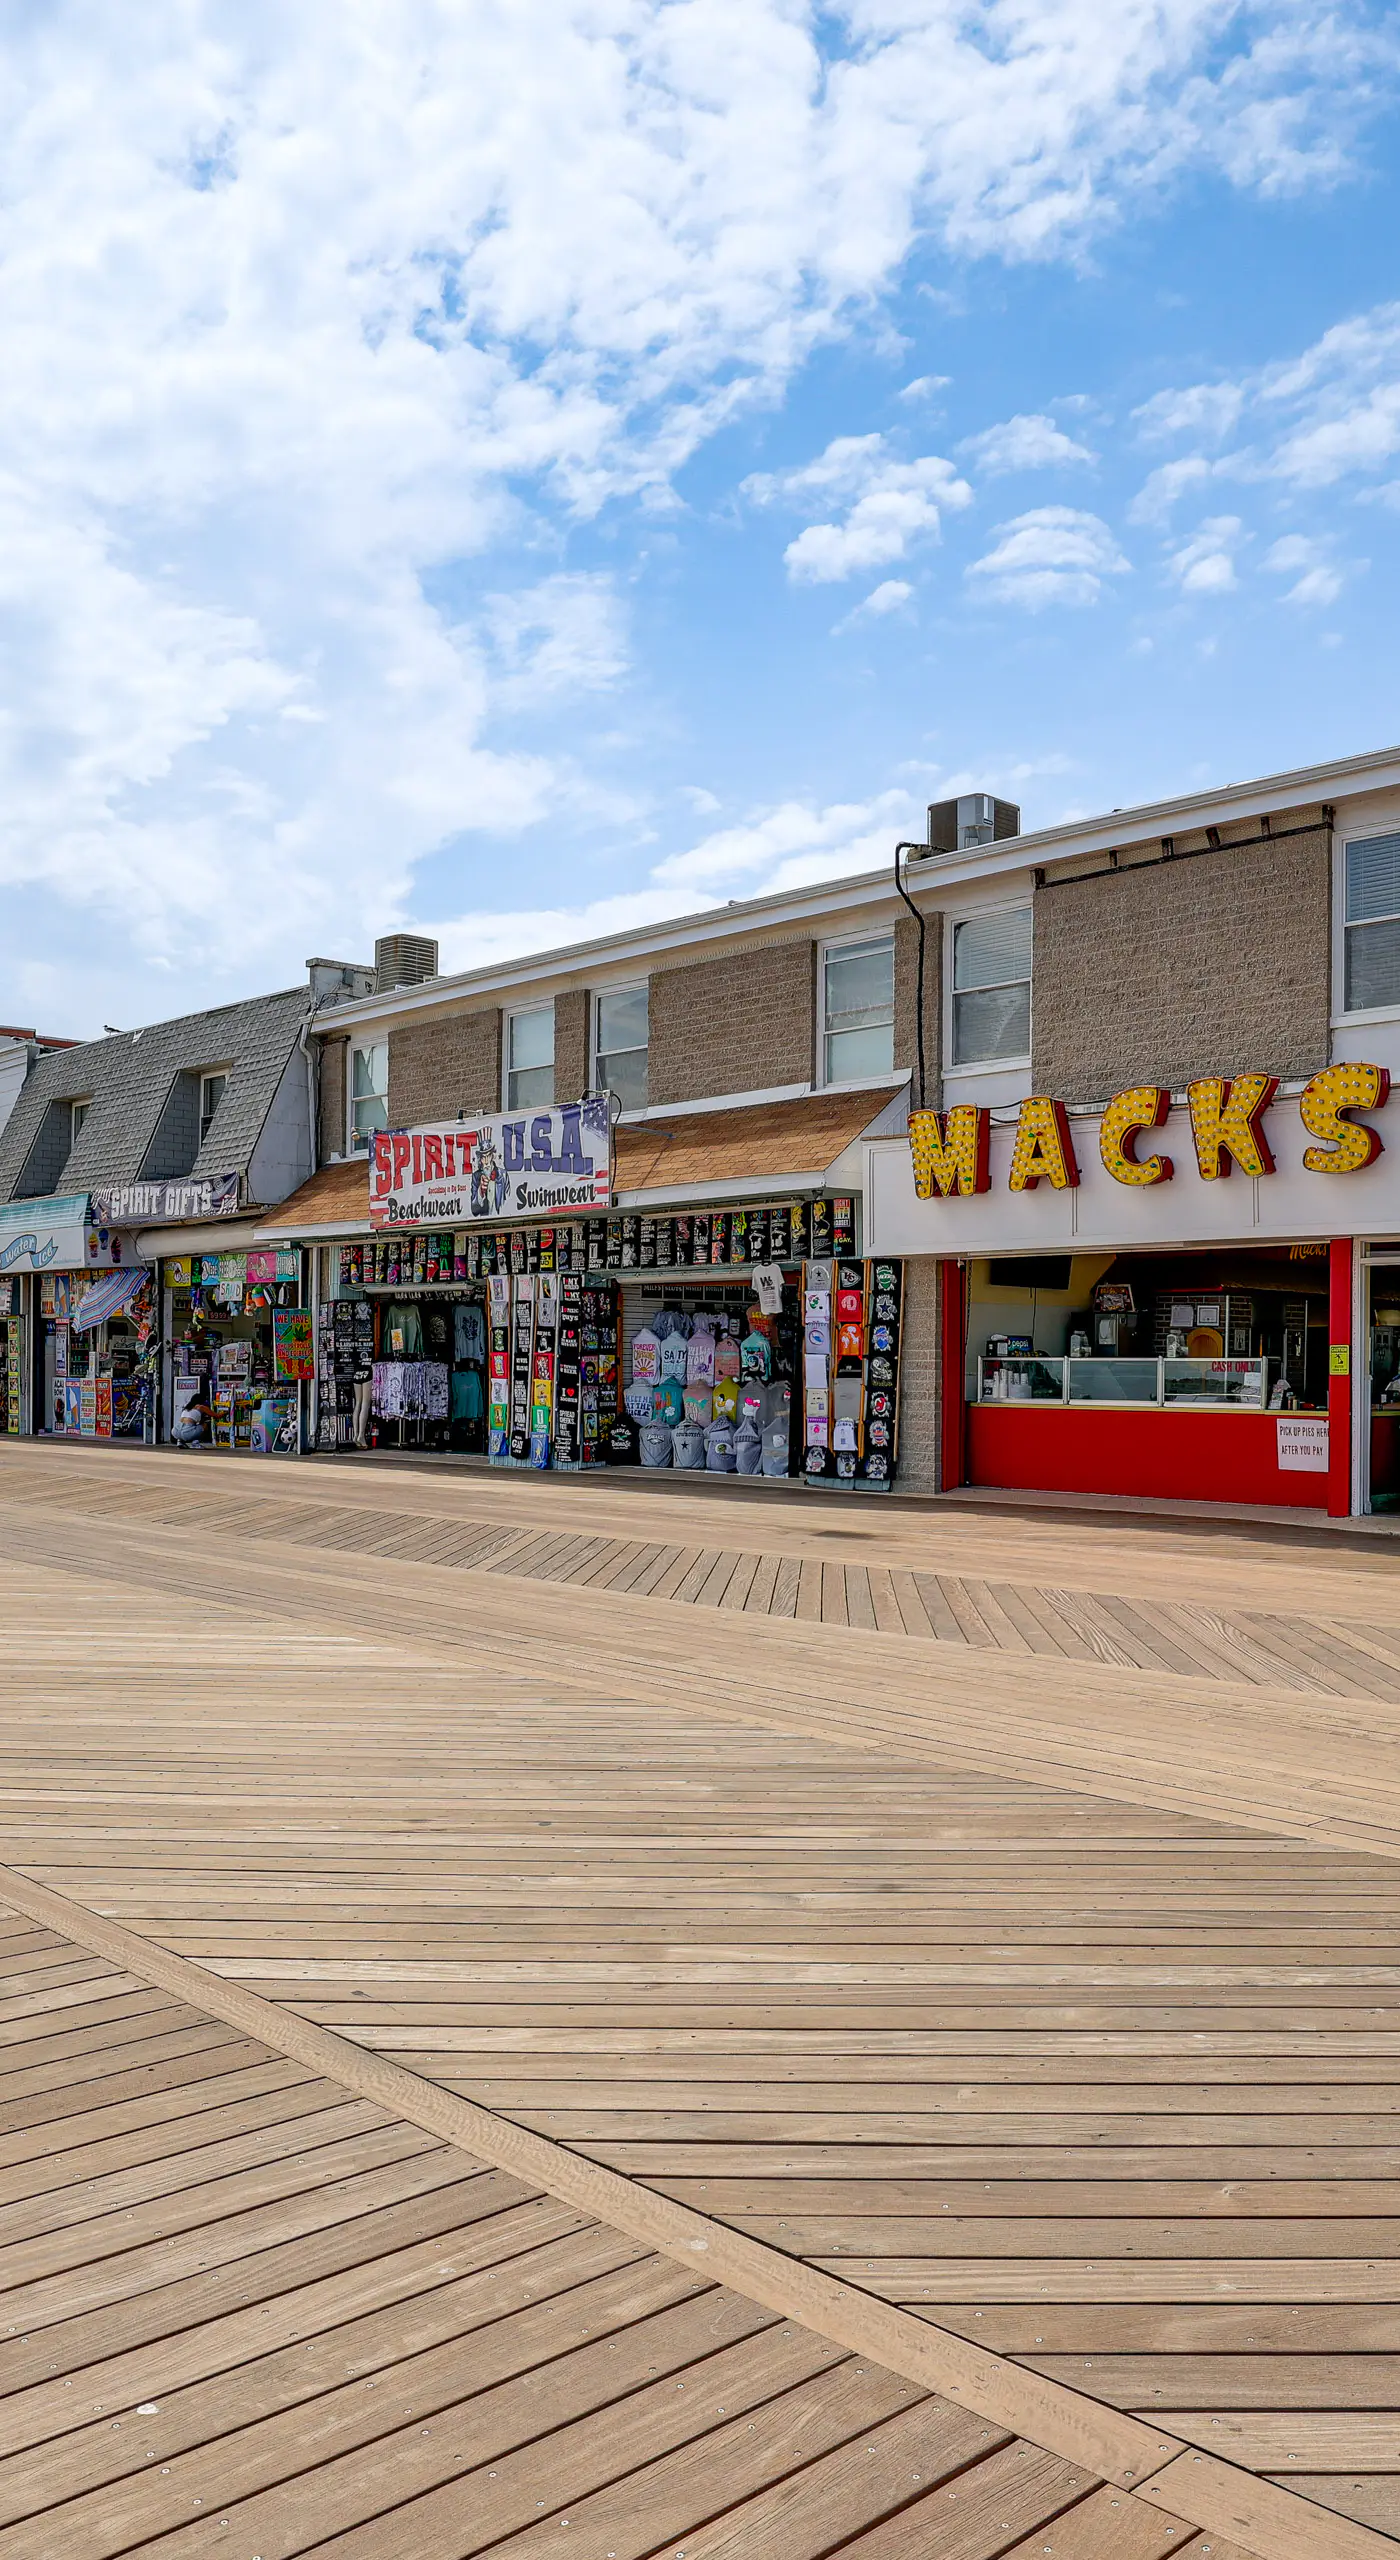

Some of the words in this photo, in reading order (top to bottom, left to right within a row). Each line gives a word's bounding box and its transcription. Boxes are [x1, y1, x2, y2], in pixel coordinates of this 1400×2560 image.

[908, 1062, 1391, 1200] MACKS
[375, 1131, 478, 1196] SPIRIT
[110, 1185, 160, 1220] SPIRIT
[164, 1180, 213, 1218] GIFTS
[388, 1195, 463, 1222] Beachwear
[516, 1181, 596, 1210] Swimwear
[38, 1246, 53, 1266] Ice
[277, 1315, 288, 1323] WE
[290, 1314, 309, 1323] HAVE
[1011, 1339, 1029, 1348] pepsi
[1211, 1361, 1232, 1372] CASH
[1235, 1361, 1256, 1372] ONLY
[1280, 1426, 1293, 1436] PICK
[1293, 1427, 1301, 1436] UP
[1302, 1427, 1315, 1437] PIES
[1281, 1445, 1299, 1455] AFTER
[1300, 1445, 1311, 1455] YOU
[1313, 1446, 1324, 1456] PAY
